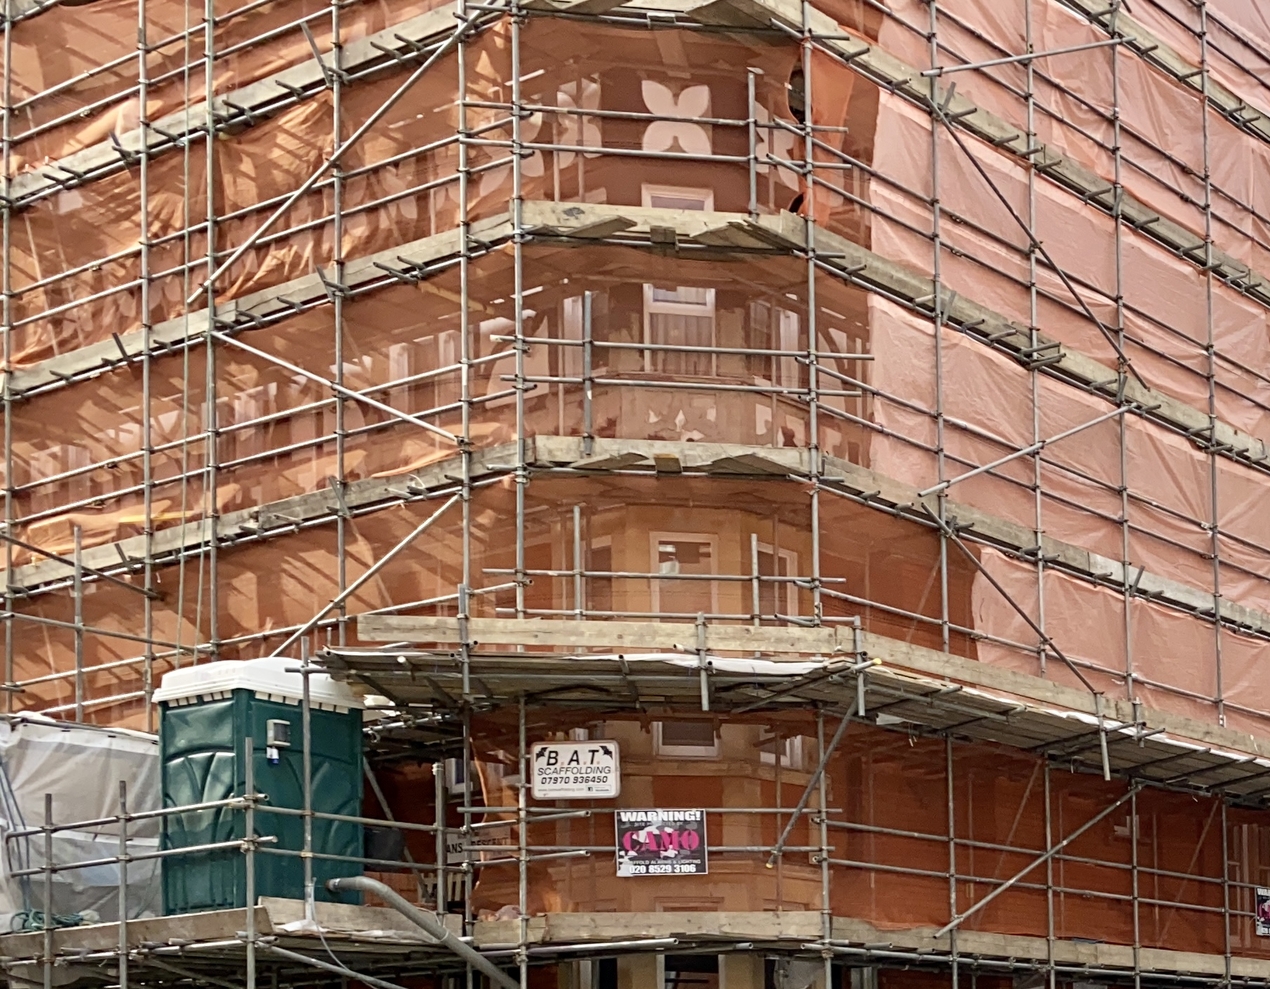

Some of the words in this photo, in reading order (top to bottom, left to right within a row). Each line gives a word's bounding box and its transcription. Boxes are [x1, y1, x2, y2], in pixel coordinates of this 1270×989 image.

[537, 766, 612, 776] SCAFFOLDING
[541, 776, 570, 784] 07970
[572, 775, 608, 784] 936450
[620, 811, 701, 822] WARNING!
[622, 830, 700, 852] CAMO
[629, 865, 646, 874] 020
[649, 865, 672, 873] 8529
[674, 864, 696, 873] 3106
